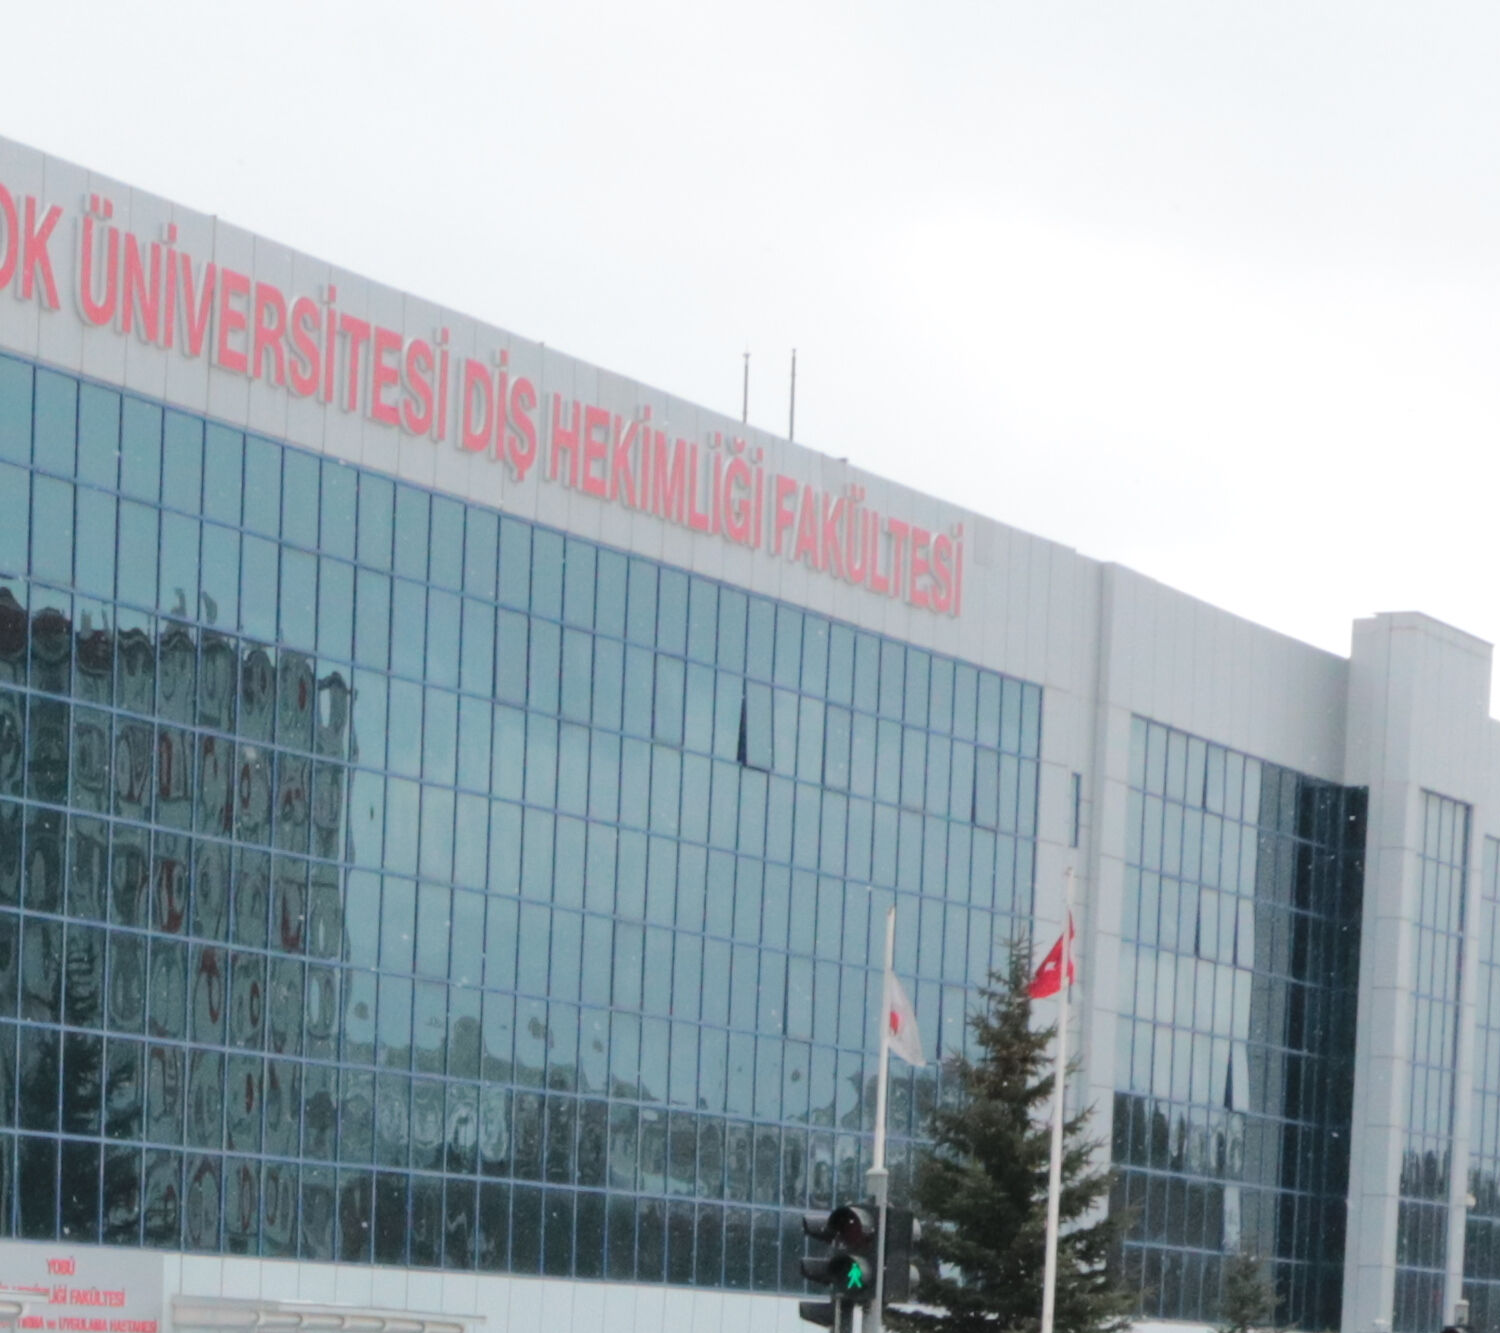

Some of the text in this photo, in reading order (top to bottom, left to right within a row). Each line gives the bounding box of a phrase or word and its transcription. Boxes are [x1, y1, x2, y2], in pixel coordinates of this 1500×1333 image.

[80, 195, 449, 441] ÜNİVERSİTESİ
[462, 348, 538, 480] DİŞ
[551, 394, 764, 549] HEKİMLİĞİ
[775, 474, 964, 617] FAKÜLTESİ
